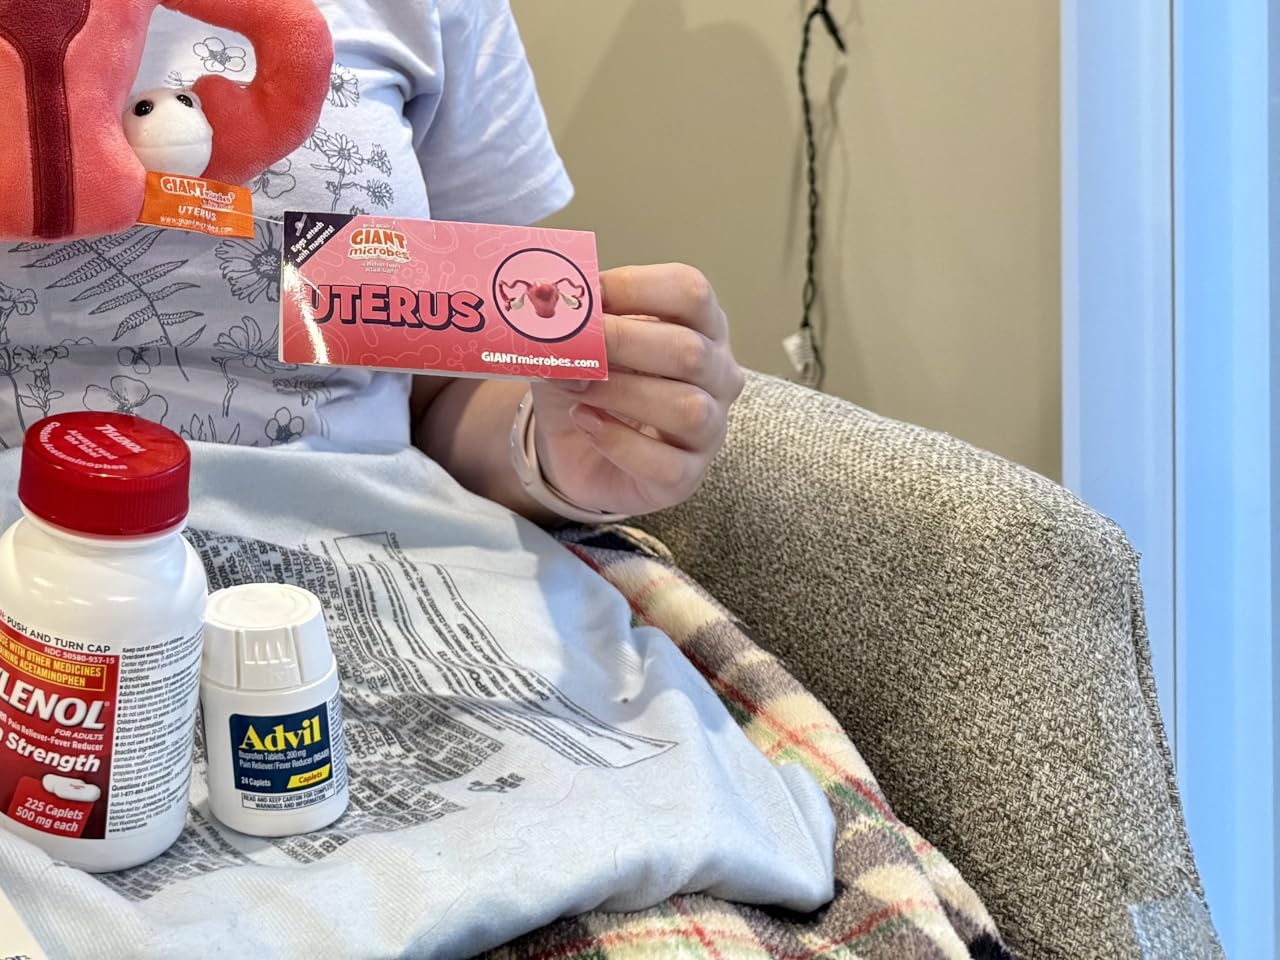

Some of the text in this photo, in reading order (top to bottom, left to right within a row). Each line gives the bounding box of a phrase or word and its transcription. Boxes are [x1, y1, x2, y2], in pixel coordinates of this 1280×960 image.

[160, 176, 206, 198] GIANT
[179, 206, 216, 221] UTERUS
[291, 221, 325, 253] Eggs attach
[296, 225, 335, 263] with magnets!
[350, 228, 406, 249] GIANT
[349, 246, 410, 261] microbes
[310, 283, 485, 331] UTERUS
[481, 351, 600, 370] GIANTmicrobes.com
[95, 424, 147, 454] TYLENOL
[42, 442, 128, 470] Acetaminophen
[316, 575, 328, 594] PAS
[327, 580, 340, 599] SUR
[7, 616, 27, 634] PUSH
[29, 630, 51, 643] AND
[54, 637, 83, 651] TURN
[87, 644, 111, 653] CAP
[0, 632, 9, 646] USE
[9, 640, 25, 658] WITH
[26, 649, 51, 666] OTHER
[53, 660, 101, 677] MEDICINES
[44, 647, 62, 656] NDC
[20, 658, 86, 687] ACETAMINOPHEN
[8, 719, 20, 731] Pain
[72, 742, 103, 751] Reducer
[54, 728, 104, 741] FOR ADULTS
[239, 715, 321, 752] Advil
[6, 732, 101, 772] Strength
[239, 750, 264, 760] Ibuprofen
[286, 751, 297, 759] 200
[240, 760, 251, 768] Pain
[292, 757, 313, 768] Reducer
[249, 777, 271, 787] Caplets
[298, 771, 322, 784] Caplets
[16, 806, 78, 832] 500 mg each
[25, 797, 84, 821] 225 Caplets
